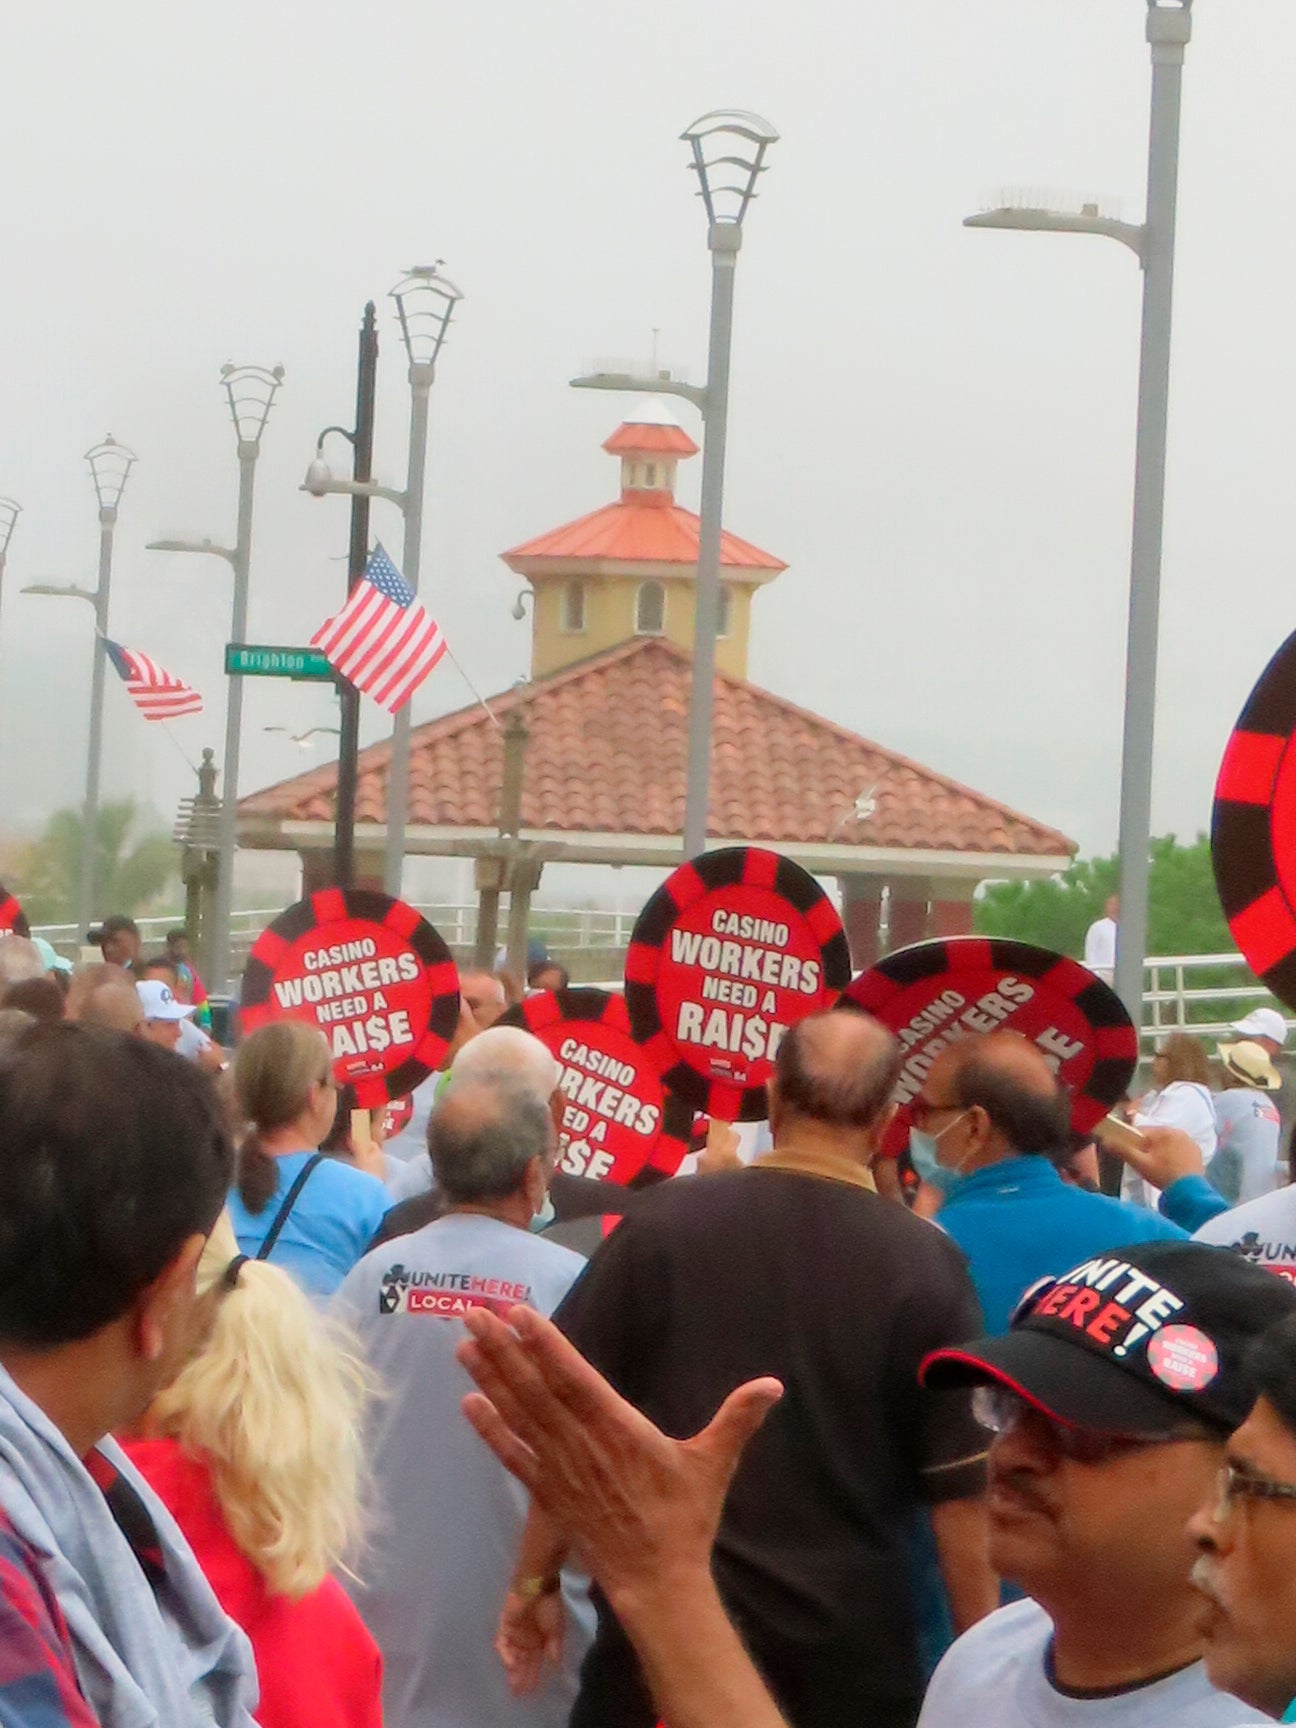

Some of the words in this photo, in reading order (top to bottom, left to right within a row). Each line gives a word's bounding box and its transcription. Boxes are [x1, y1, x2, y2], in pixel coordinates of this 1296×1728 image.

[712, 908, 789, 948] CASINO
[304, 937, 376, 970] CASINO
[672, 928, 821, 995] WORKERS
[274, 952, 419, 1008] WORKERS
[702, 975, 758, 1009] NEED
[761, 990, 776, 1014] A
[316, 995, 368, 1023] NEED
[373, 991, 387, 1012] A
[899, 989, 966, 1054] ASINO
[319, 1010, 414, 1059] AI$E
[560, 1037, 637, 1088] CASINO
[589, 1120, 607, 1143] A
